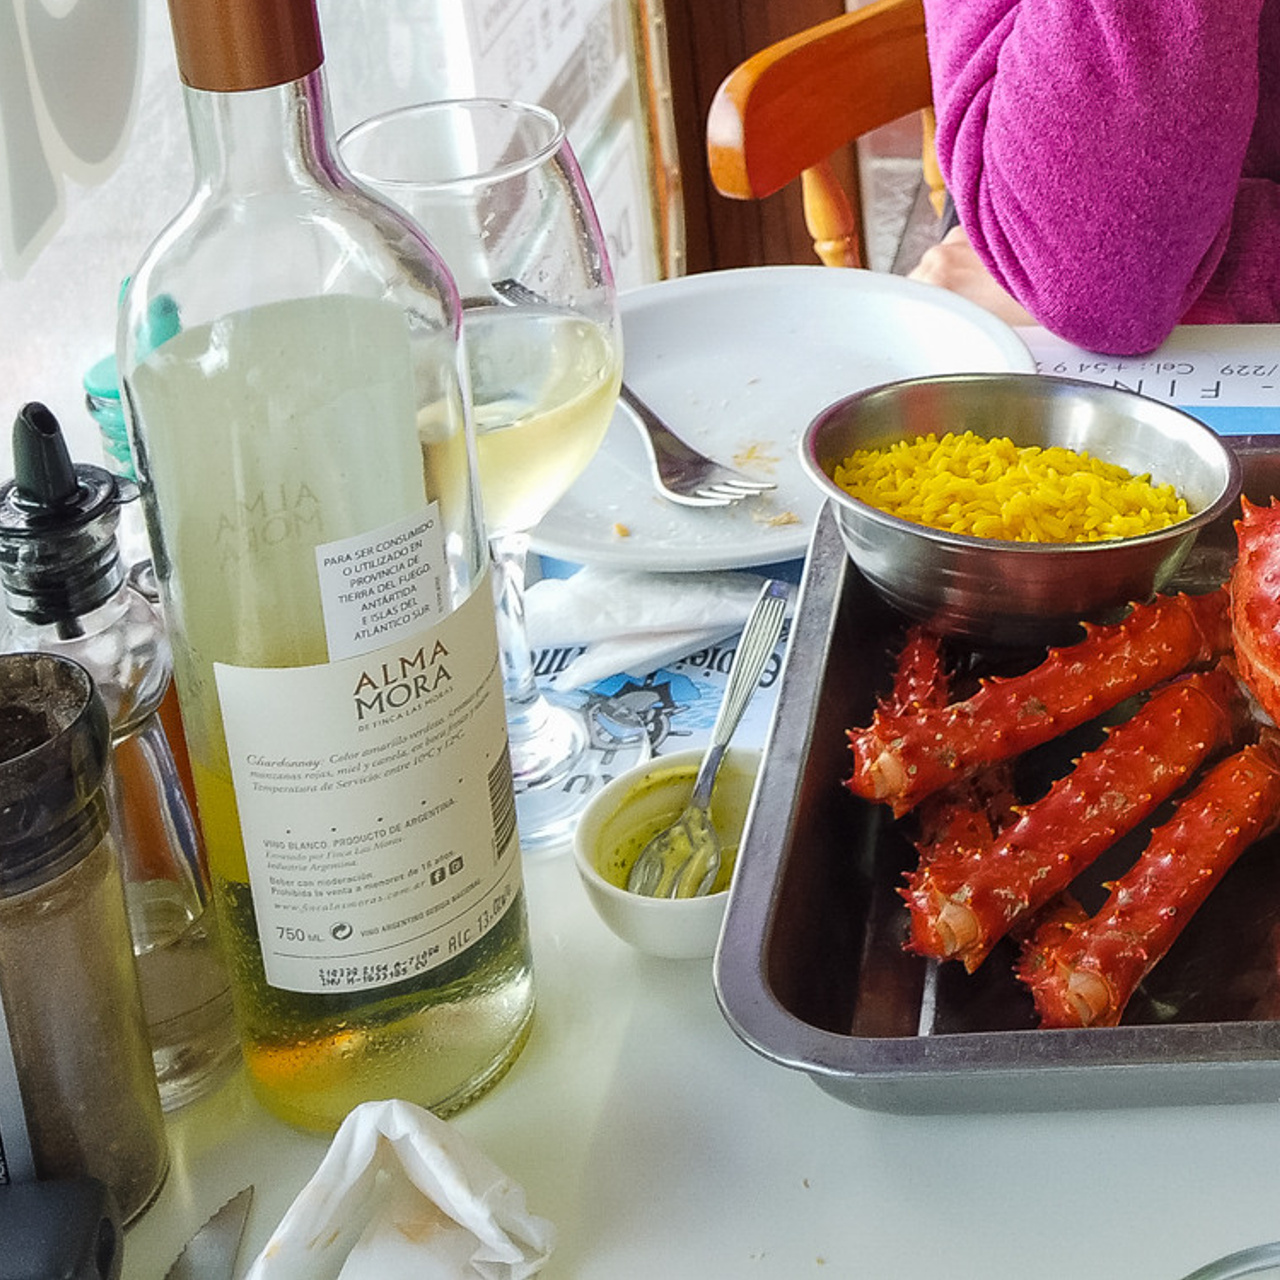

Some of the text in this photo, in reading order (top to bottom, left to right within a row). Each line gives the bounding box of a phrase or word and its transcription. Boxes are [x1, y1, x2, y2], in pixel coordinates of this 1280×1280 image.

[1053, 361, 1068, 372] 9
[1078, 361, 1126, 374] +54
[323, 519, 435, 568] PARA SER CONSUMIDO
[342, 539, 423, 576] O UTILIZADO EN
[350, 554, 419, 588] PROVINCIA DE
[338, 587, 375, 605] TIERRA
[377, 579, 396, 594] DEL
[370, 605, 399, 623] ISLAS
[400, 597, 418, 612] DEL
[412, 604, 431, 620] SUR
[354, 639, 449, 696] ALMA
[354, 664, 452, 720] MORA
[358, 724, 370, 733] DE
[373, 713, 404, 730] FINCA
[405, 703, 422, 717] LAS
[329, 750, 360, 764] Color
[361, 734, 408, 757] amarillo
[337, 761, 361, 775] miel
[252, 781, 318, 795] Temperatura
[320, 781, 335, 792] de
[262, 839, 286, 850] VINO
[288, 840, 327, 851] BLANCO
[333, 828, 387, 848] PRODUCTO
[388, 822, 401, 835] DE
[270, 885, 313, 898] Prohibida
[326, 886, 353, 897] venta
[364, 873, 404, 890] menores
[276, 926, 305, 942] 750
